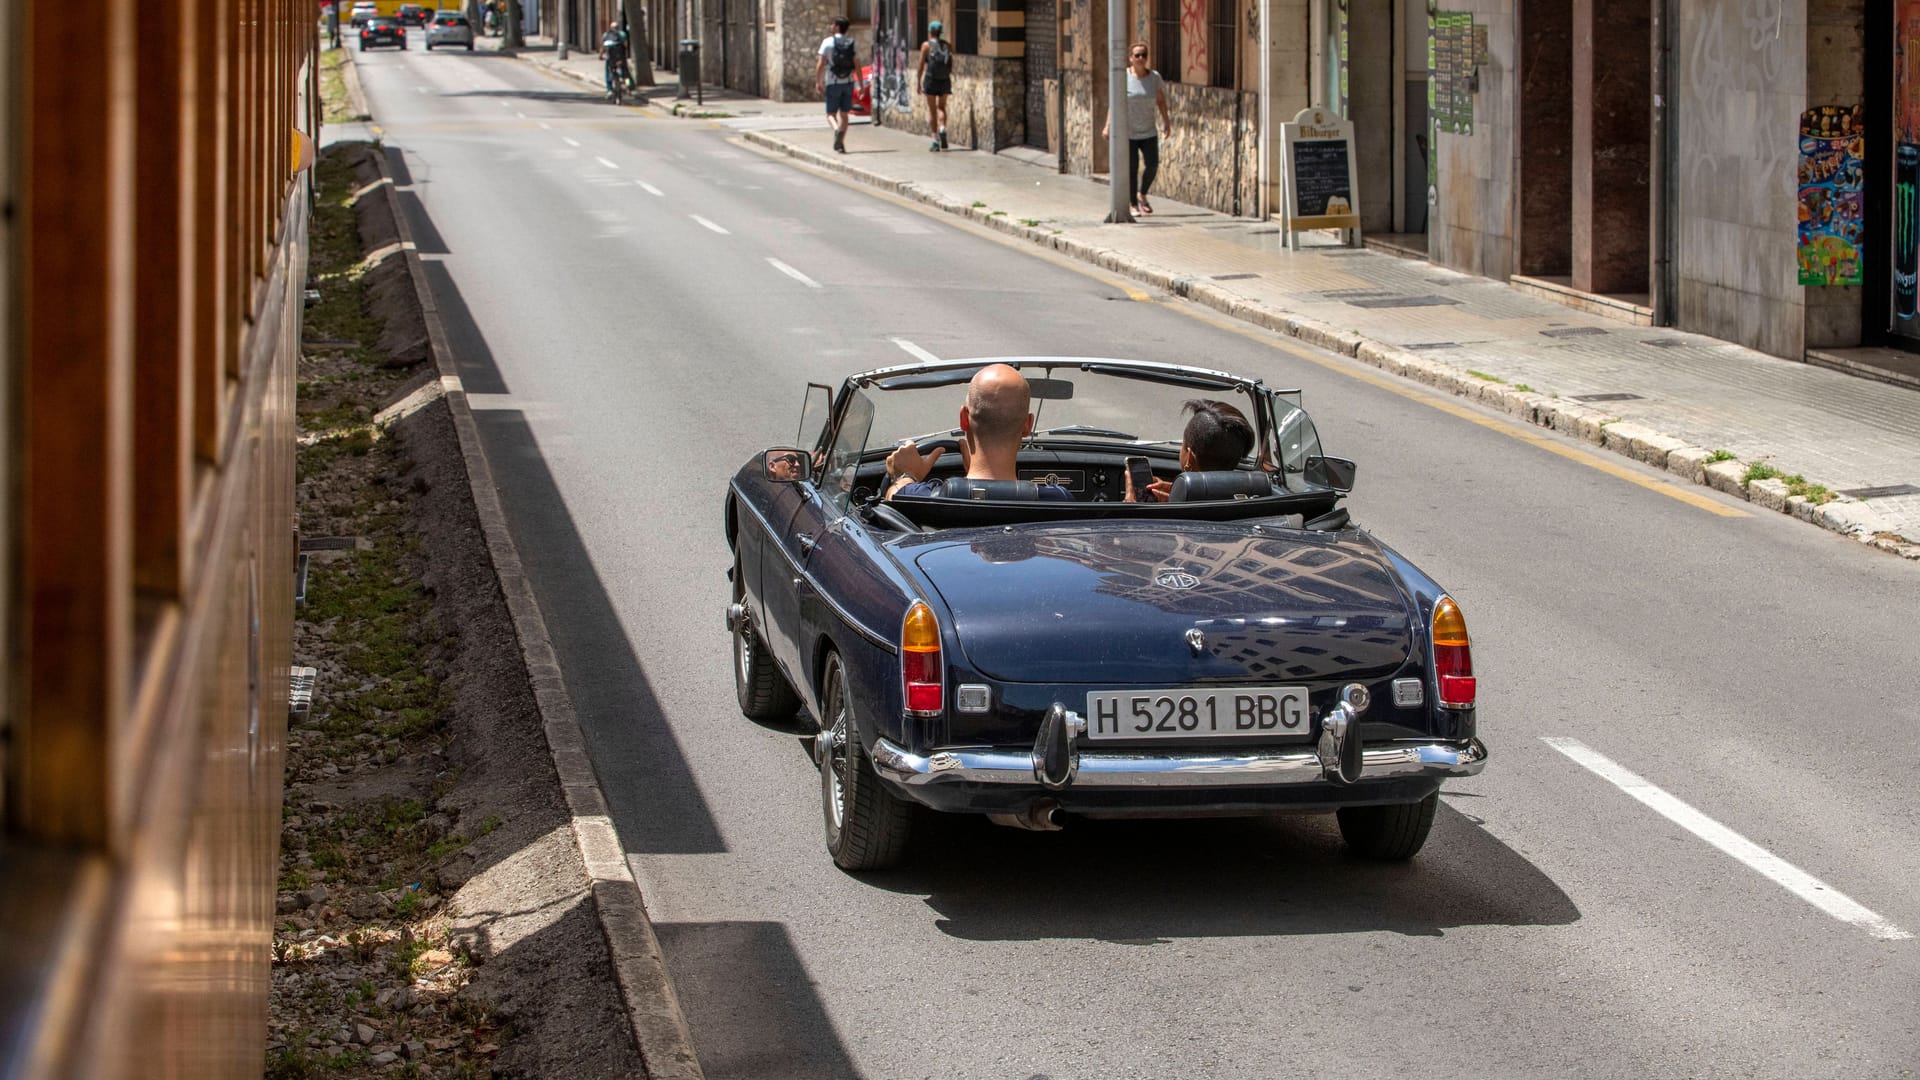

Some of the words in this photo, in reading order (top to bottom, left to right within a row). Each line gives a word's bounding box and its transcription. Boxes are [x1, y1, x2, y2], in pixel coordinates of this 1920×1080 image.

[1097, 698, 1118, 733] H
[1132, 695, 1217, 732] 5281
[1235, 694, 1300, 729] BBG
